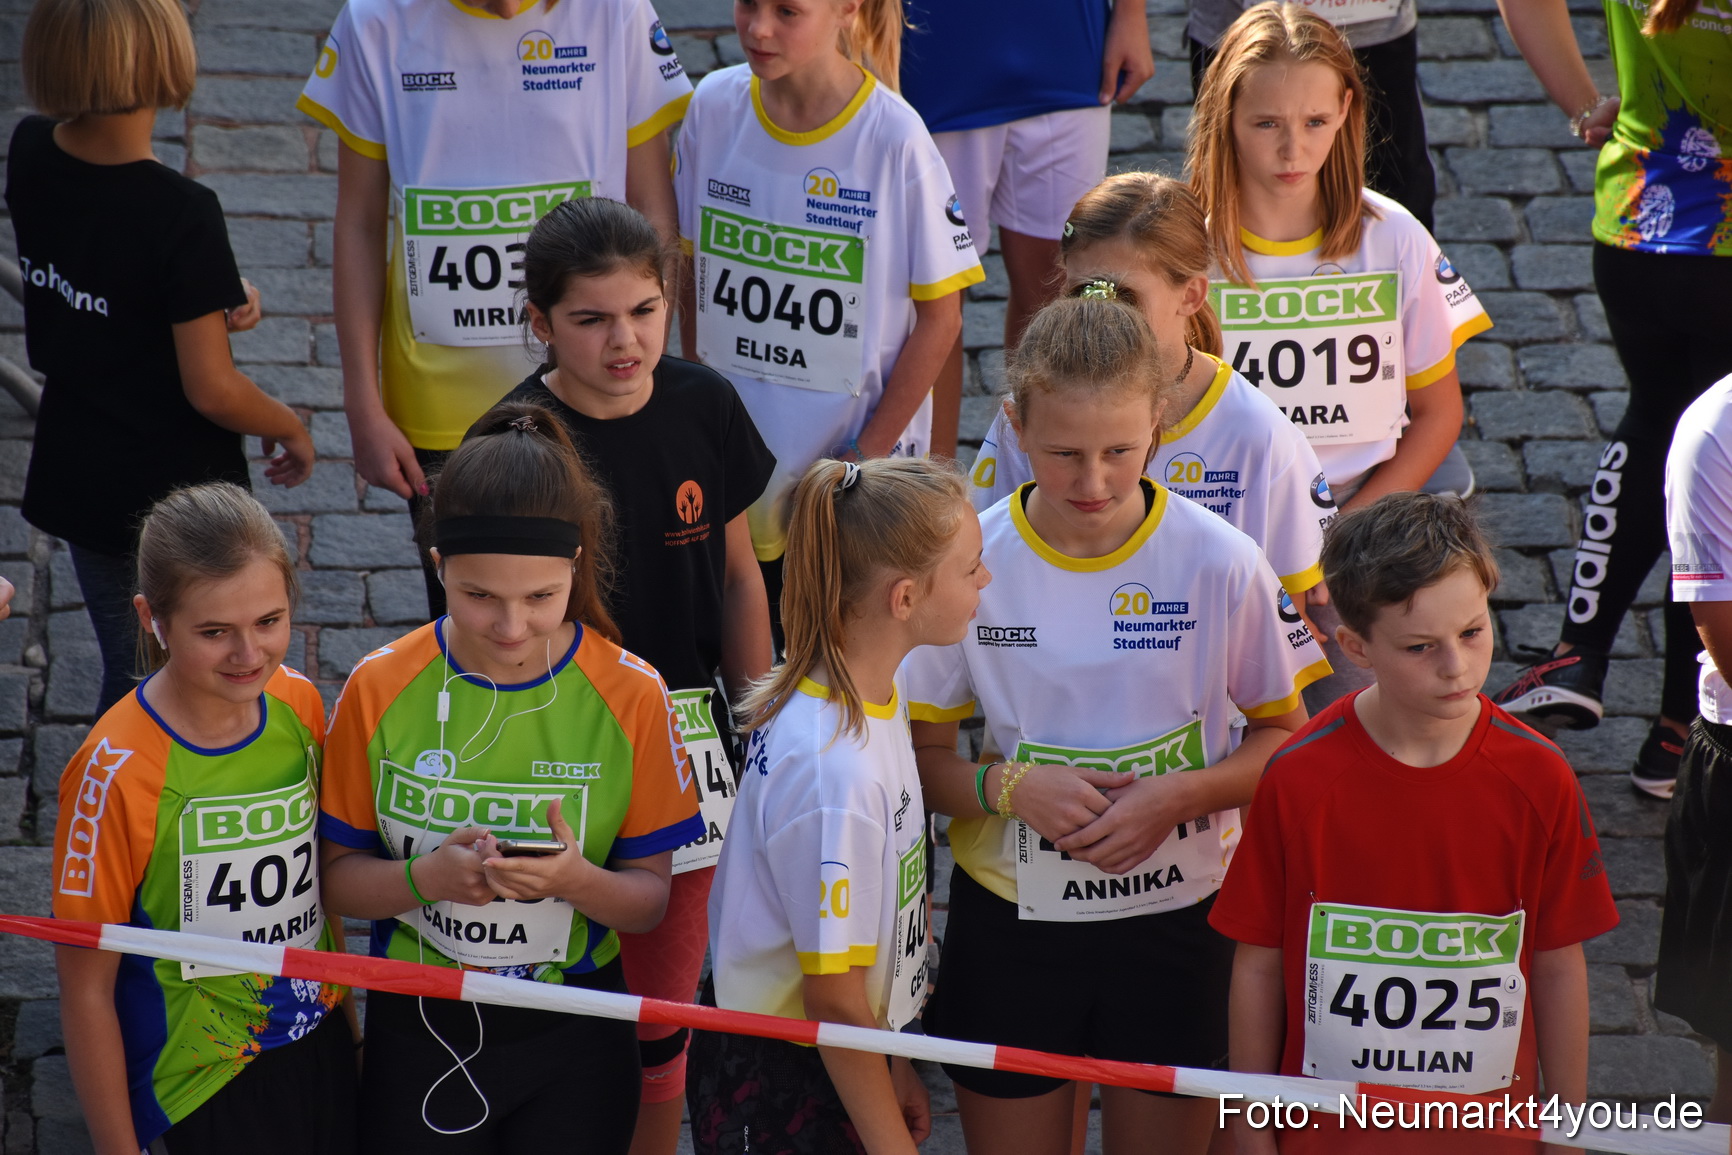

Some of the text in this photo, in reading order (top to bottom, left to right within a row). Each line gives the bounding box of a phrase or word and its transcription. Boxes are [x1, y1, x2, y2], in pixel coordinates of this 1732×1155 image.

[315, 46, 337, 79] 0
[522, 39, 586, 61] 20 JAHRE
[402, 72, 457, 87] BOCK
[522, 62, 596, 76] Neumarkter
[522, 77, 583, 91] Stadtlauf
[708, 179, 751, 202] BOCK
[807, 175, 869, 201] 20 JAHRE
[806, 198, 878, 218] Neumarkter
[806, 212, 863, 233] Stadtlauf
[710, 216, 851, 276] BOCK
[428, 243, 527, 291] 403
[713, 268, 844, 336] 4040
[849, 296, 856, 305] J
[1221, 280, 1385, 325] BOCK
[735, 336, 807, 369] ELISA
[1385, 335, 1392, 345] J
[1232, 334, 1380, 389] 4019
[973, 457, 997, 488] 0
[1169, 461, 1236, 484] 20 JAHRE
[1568, 441, 1628, 624] adidas
[1115, 592, 1187, 616] 20 JAHRE
[977, 626, 1037, 642] BOCK
[1113, 618, 1197, 632] Neumarkter
[1113, 636, 1182, 651] Stadtlauf
[532, 761, 601, 780] BOCK
[197, 787, 317, 847] BOC
[389, 773, 565, 833] BOCK
[59, 737, 134, 898] BOCK
[206, 838, 319, 912] 402
[1062, 864, 1184, 900] ANNIKA
[242, 903, 317, 944] MARIE
[422, 904, 528, 944] CAROLA
[1325, 913, 1510, 961] BOCK
[1509, 979, 1516, 990] J
[1330, 973, 1501, 1031] 4025
[1352, 1048, 1473, 1073] JULIAN
